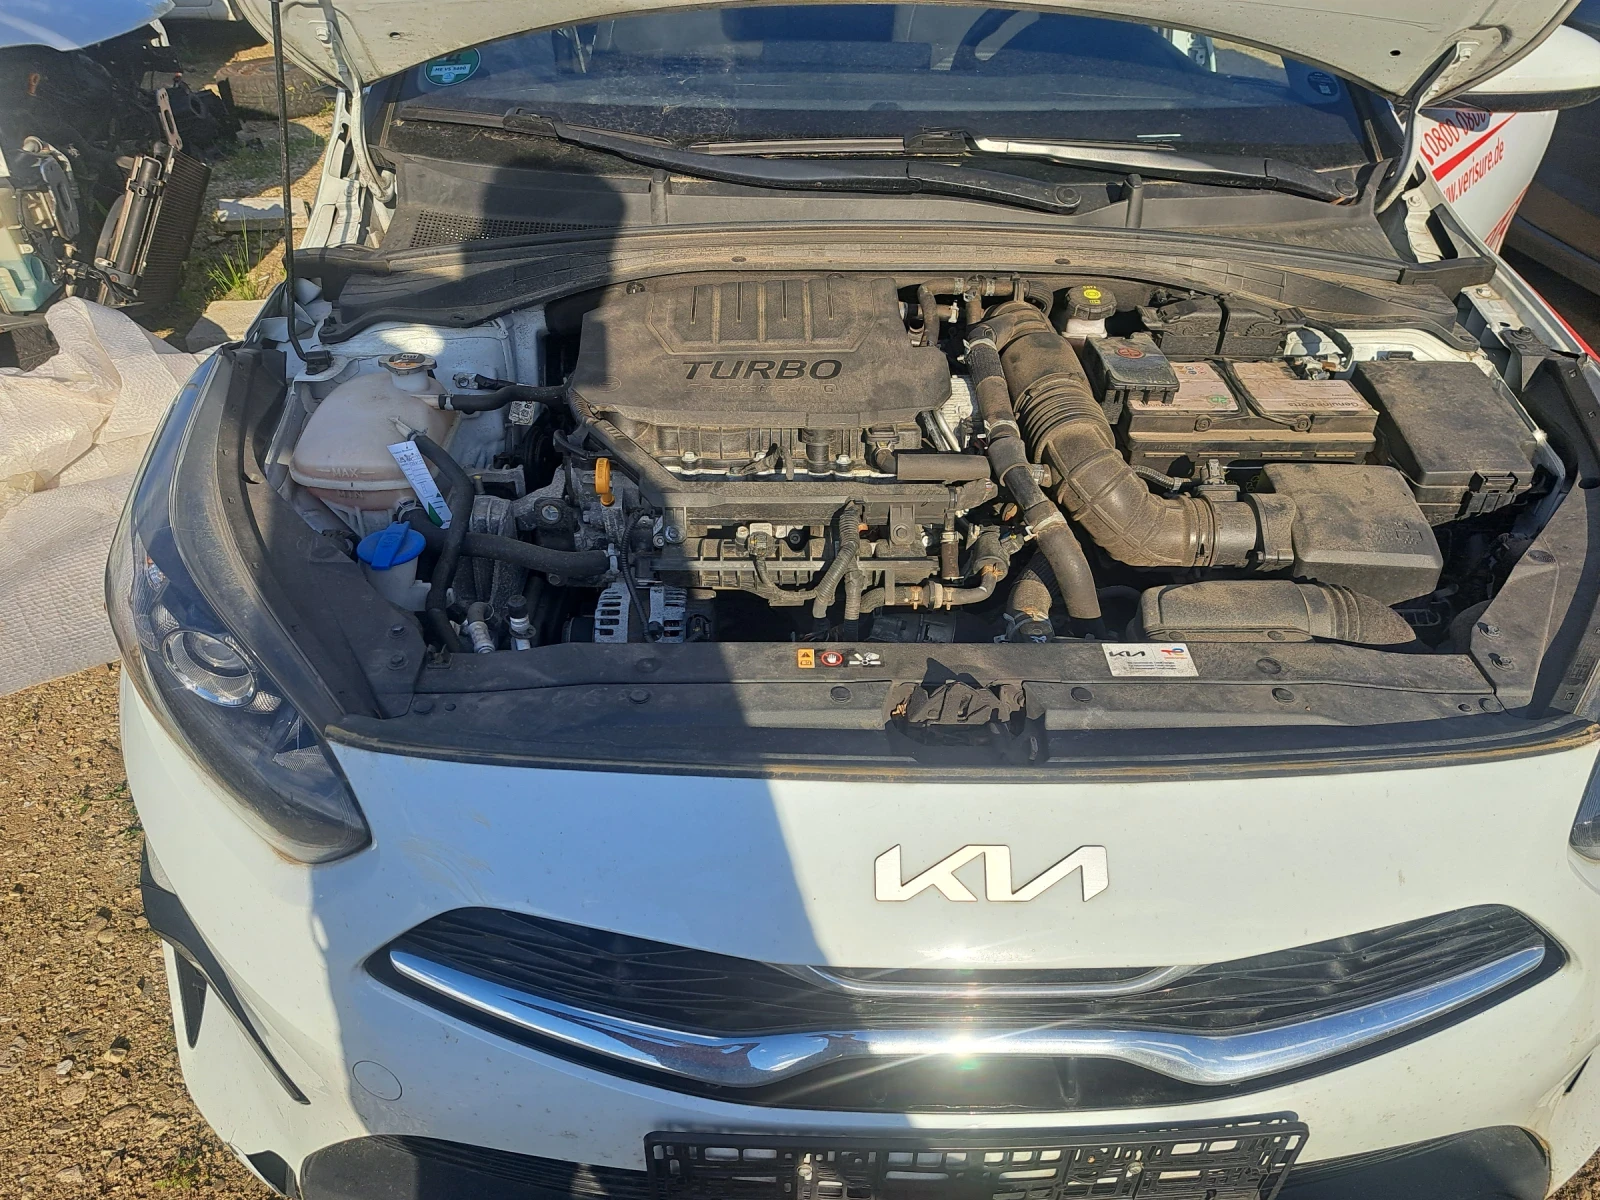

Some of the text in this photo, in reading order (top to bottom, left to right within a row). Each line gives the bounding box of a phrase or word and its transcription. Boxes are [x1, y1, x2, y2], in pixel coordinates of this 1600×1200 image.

[1424, 118, 1460, 157] 0800
[682, 359, 843, 380] TURBO
[331, 467, 359, 478] MAX
[873, 843, 1109, 903] KIA
